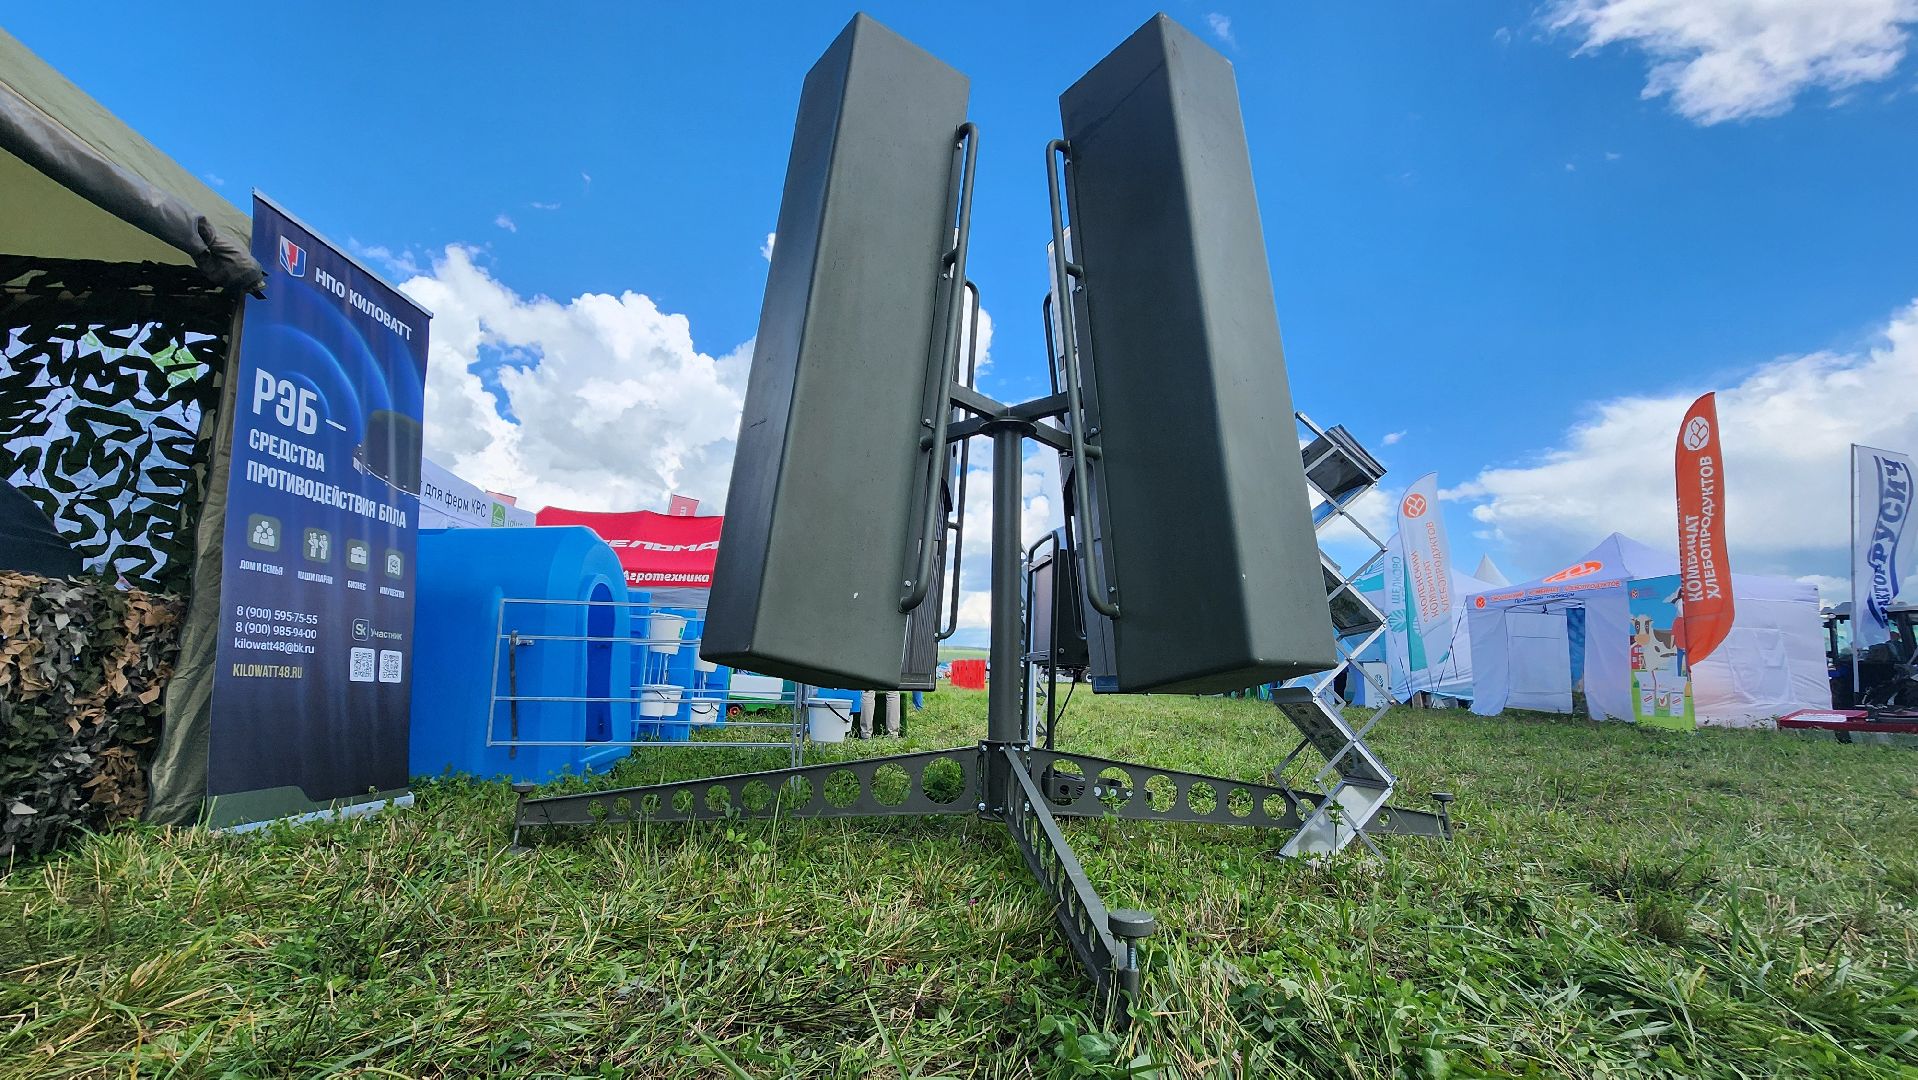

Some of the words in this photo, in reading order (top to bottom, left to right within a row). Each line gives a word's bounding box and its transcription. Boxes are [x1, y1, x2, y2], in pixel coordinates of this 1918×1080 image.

[315, 267, 346, 299] НПО
[349, 289, 413, 341] КИЛОВАТТ
[252, 367, 318, 436] РЭБ
[249, 428, 325, 473] СРЕДСТВА
[247, 460, 376, 519] ПРОТИВОДЕЙСТВИЯ
[378, 504, 407, 529] БПЛА
[424, 483, 443, 502] для
[444, 489, 469, 513] ферм
[471, 498, 487, 518] КРС
[1872, 456, 1908, 564] РУСИЧ
[1700, 455, 1722, 600] ХЛЕБОПРОДУКТОВ
[239, 560, 256, 571] ДОМ
[256, 562, 262, 572] И
[262, 563, 284, 576] СЕМЬЯ
[297, 570, 316, 582] НАШИ
[1426, 521, 1450, 612] ХЛЕБОПРОДУКТОВ
[1685, 515, 1704, 602] КОМБИНАТ
[347, 580, 367, 591] БИЗНЕС
[624, 570, 710, 583] Агротехника
[1424, 560, 1439, 618] КОМБИНАТ
[235, 621, 243, 633] 8
[244, 621, 271, 637] (900)
[273, 625, 317, 639] 985-94-00
[236, 605, 244, 616] 8
[245, 606, 272, 622] (900)
[274, 610, 318, 625] 595-75-55
[234, 637, 315, 655] kilowatt48@bk.ru
[370, 628, 403, 641] Участник
[232, 663, 303, 679] KILOWATT48.RU
